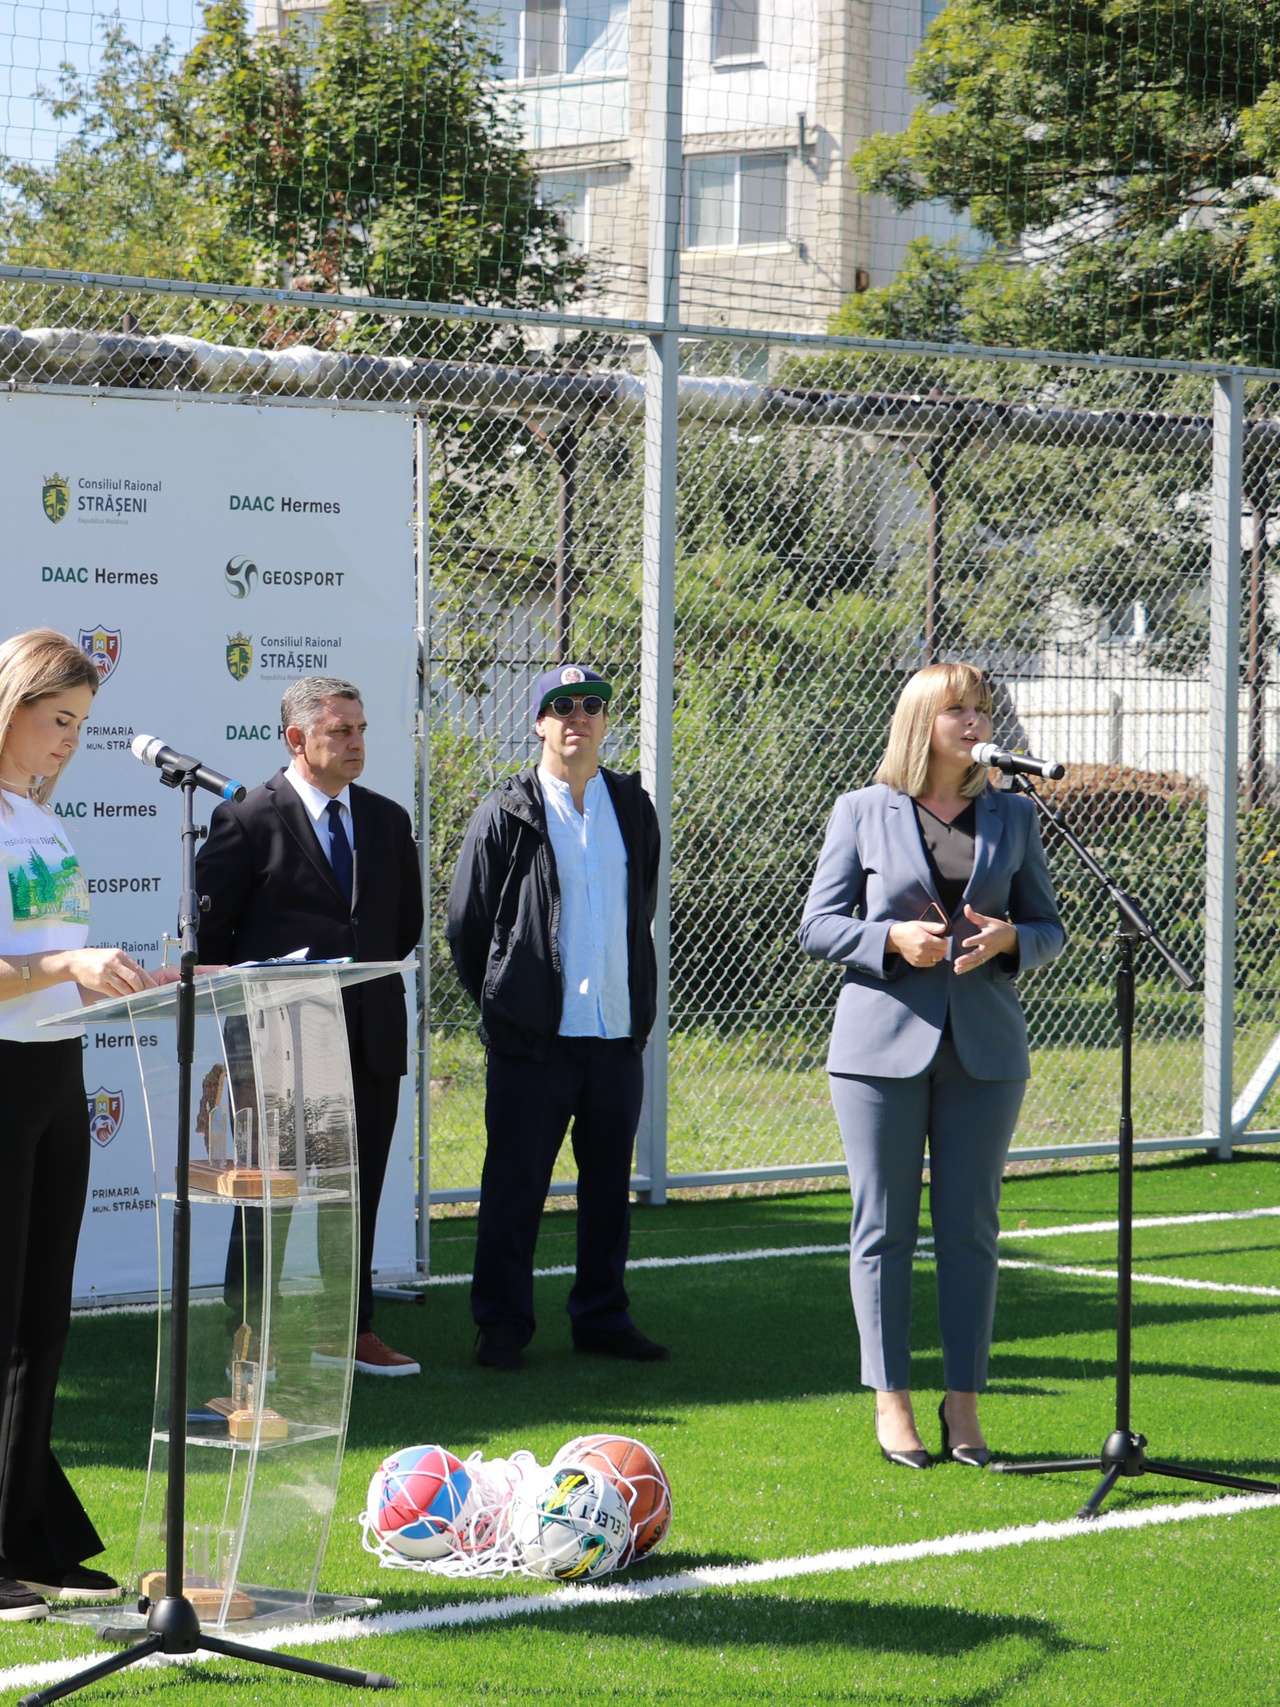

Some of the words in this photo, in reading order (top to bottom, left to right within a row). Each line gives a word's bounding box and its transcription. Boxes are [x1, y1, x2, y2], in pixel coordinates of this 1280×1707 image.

[78, 478, 122, 490] Consiliul
[124, 480, 162, 492] Raional
[78, 494, 147, 516] STRĂȘENI
[229, 495, 275, 512] DAAC
[281, 497, 341, 514] Hermes
[42, 567, 89, 583] DAAC
[95, 568, 159, 585] Hermes
[262, 570, 344, 586] GEOSPORT
[84, 639, 116, 650] FMF
[261, 636, 303, 647] Consiliul
[305, 637, 342, 647] Raional
[260, 651, 327, 673] STRĂȘENI
[86, 726, 134, 736] PRIMARIA
[226, 725, 271, 740] DAAC
[52, 802, 87, 817] AAC
[93, 802, 157, 817] Hermes
[88, 877, 162, 893] EOSPORT
[122, 941, 159, 952] Raional
[87, 1101, 118, 1112] FMF
[92, 1187, 140, 1198] PRIMARIA
[92, 1205, 111, 1213] MUN.
